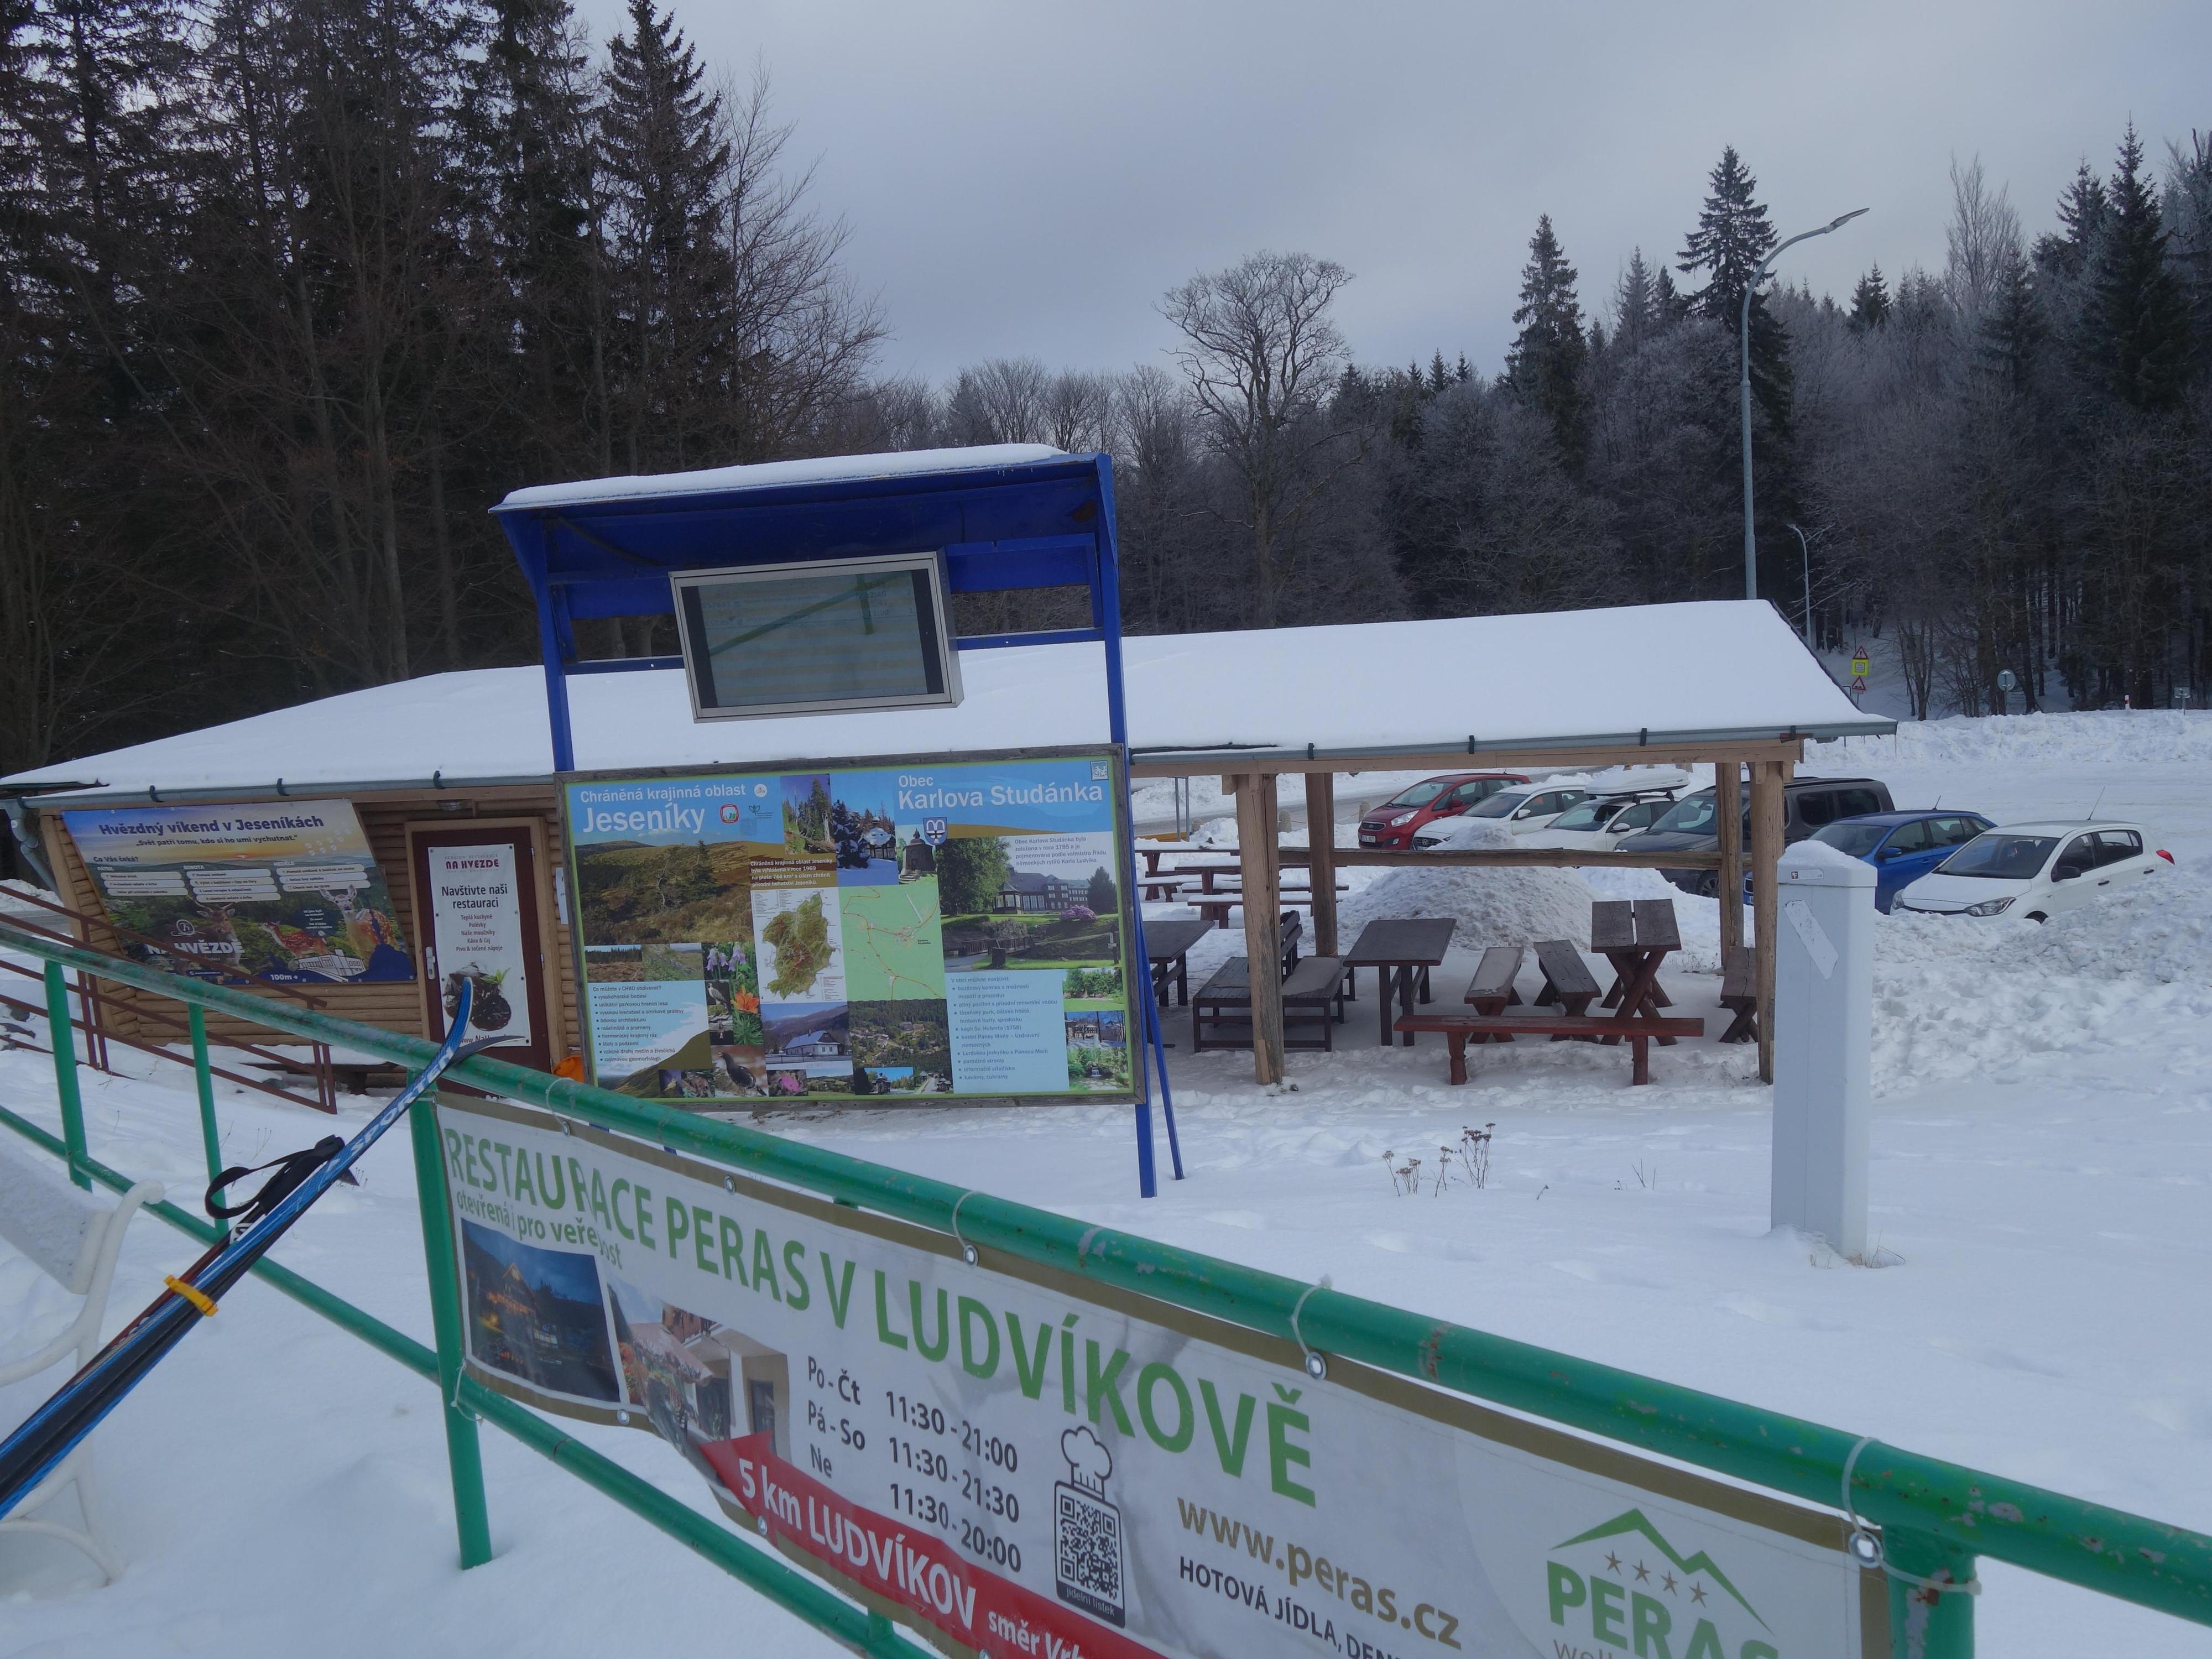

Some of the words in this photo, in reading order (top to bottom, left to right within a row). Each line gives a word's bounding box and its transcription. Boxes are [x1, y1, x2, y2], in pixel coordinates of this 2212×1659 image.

[580, 789, 643, 803] Chráněná
[647, 785, 701, 801] krajinná
[705, 784, 746, 797] oblast
[898, 775, 933, 788] Obec
[898, 788, 983, 810] Karlova
[991, 782, 1103, 806] Studánka
[99, 822, 163, 836] Hvězdný
[167, 820, 220, 833] víkend
[222, 822, 231, 831] v
[235, 816, 324, 831] Jeseníkách
[582, 802, 706, 834] Jeseníky
[442, 885, 486, 896] Navštivte
[489, 884, 508, 894] naši
[453, 897, 498, 909] restauraci
[350, 1046, 455, 1157] SPORTEN
[456, 1192, 510, 1227] otevřená
[518, 1214, 545, 1241] pro
[444, 1128, 656, 1251] RESTAURACE
[666, 1196, 810, 1311] PERAS
[820, 1251, 856, 1329] V
[874, 1268, 1317, 1508] LUDVÍKOVĚ
[808, 1355, 824, 1389] Po
[838, 1368, 860, 1406] Čt
[886, 1391, 945, 1435] 11:30
[962, 1420, 1018, 1473] 21:00
[808, 1400, 826, 1433] Pá
[840, 1418, 865, 1451] So
[890, 1437, 947, 1482] 11:30
[962, 1469, 1019, 1522] 21:30
[810, 1443, 832, 1478] Ne
[890, 1484, 948, 1530] 11:30
[961, 1519, 1021, 1573] 20:00
[739, 1458, 756, 1499] 5
[761, 1465, 802, 1531] km
[808, 1495, 977, 1631] LUDVÍKOV
[988, 1611, 1040, 1655] směr
[1176, 1496, 1462, 1651] www.peras.cz
[1067, 1588, 1090, 1604] jídelní
[1093, 1602, 1114, 1616] lístek
[1180, 1556, 1269, 1615] HOTOVÁ
[1275, 1597, 1342, 1653] JÍDLA,
